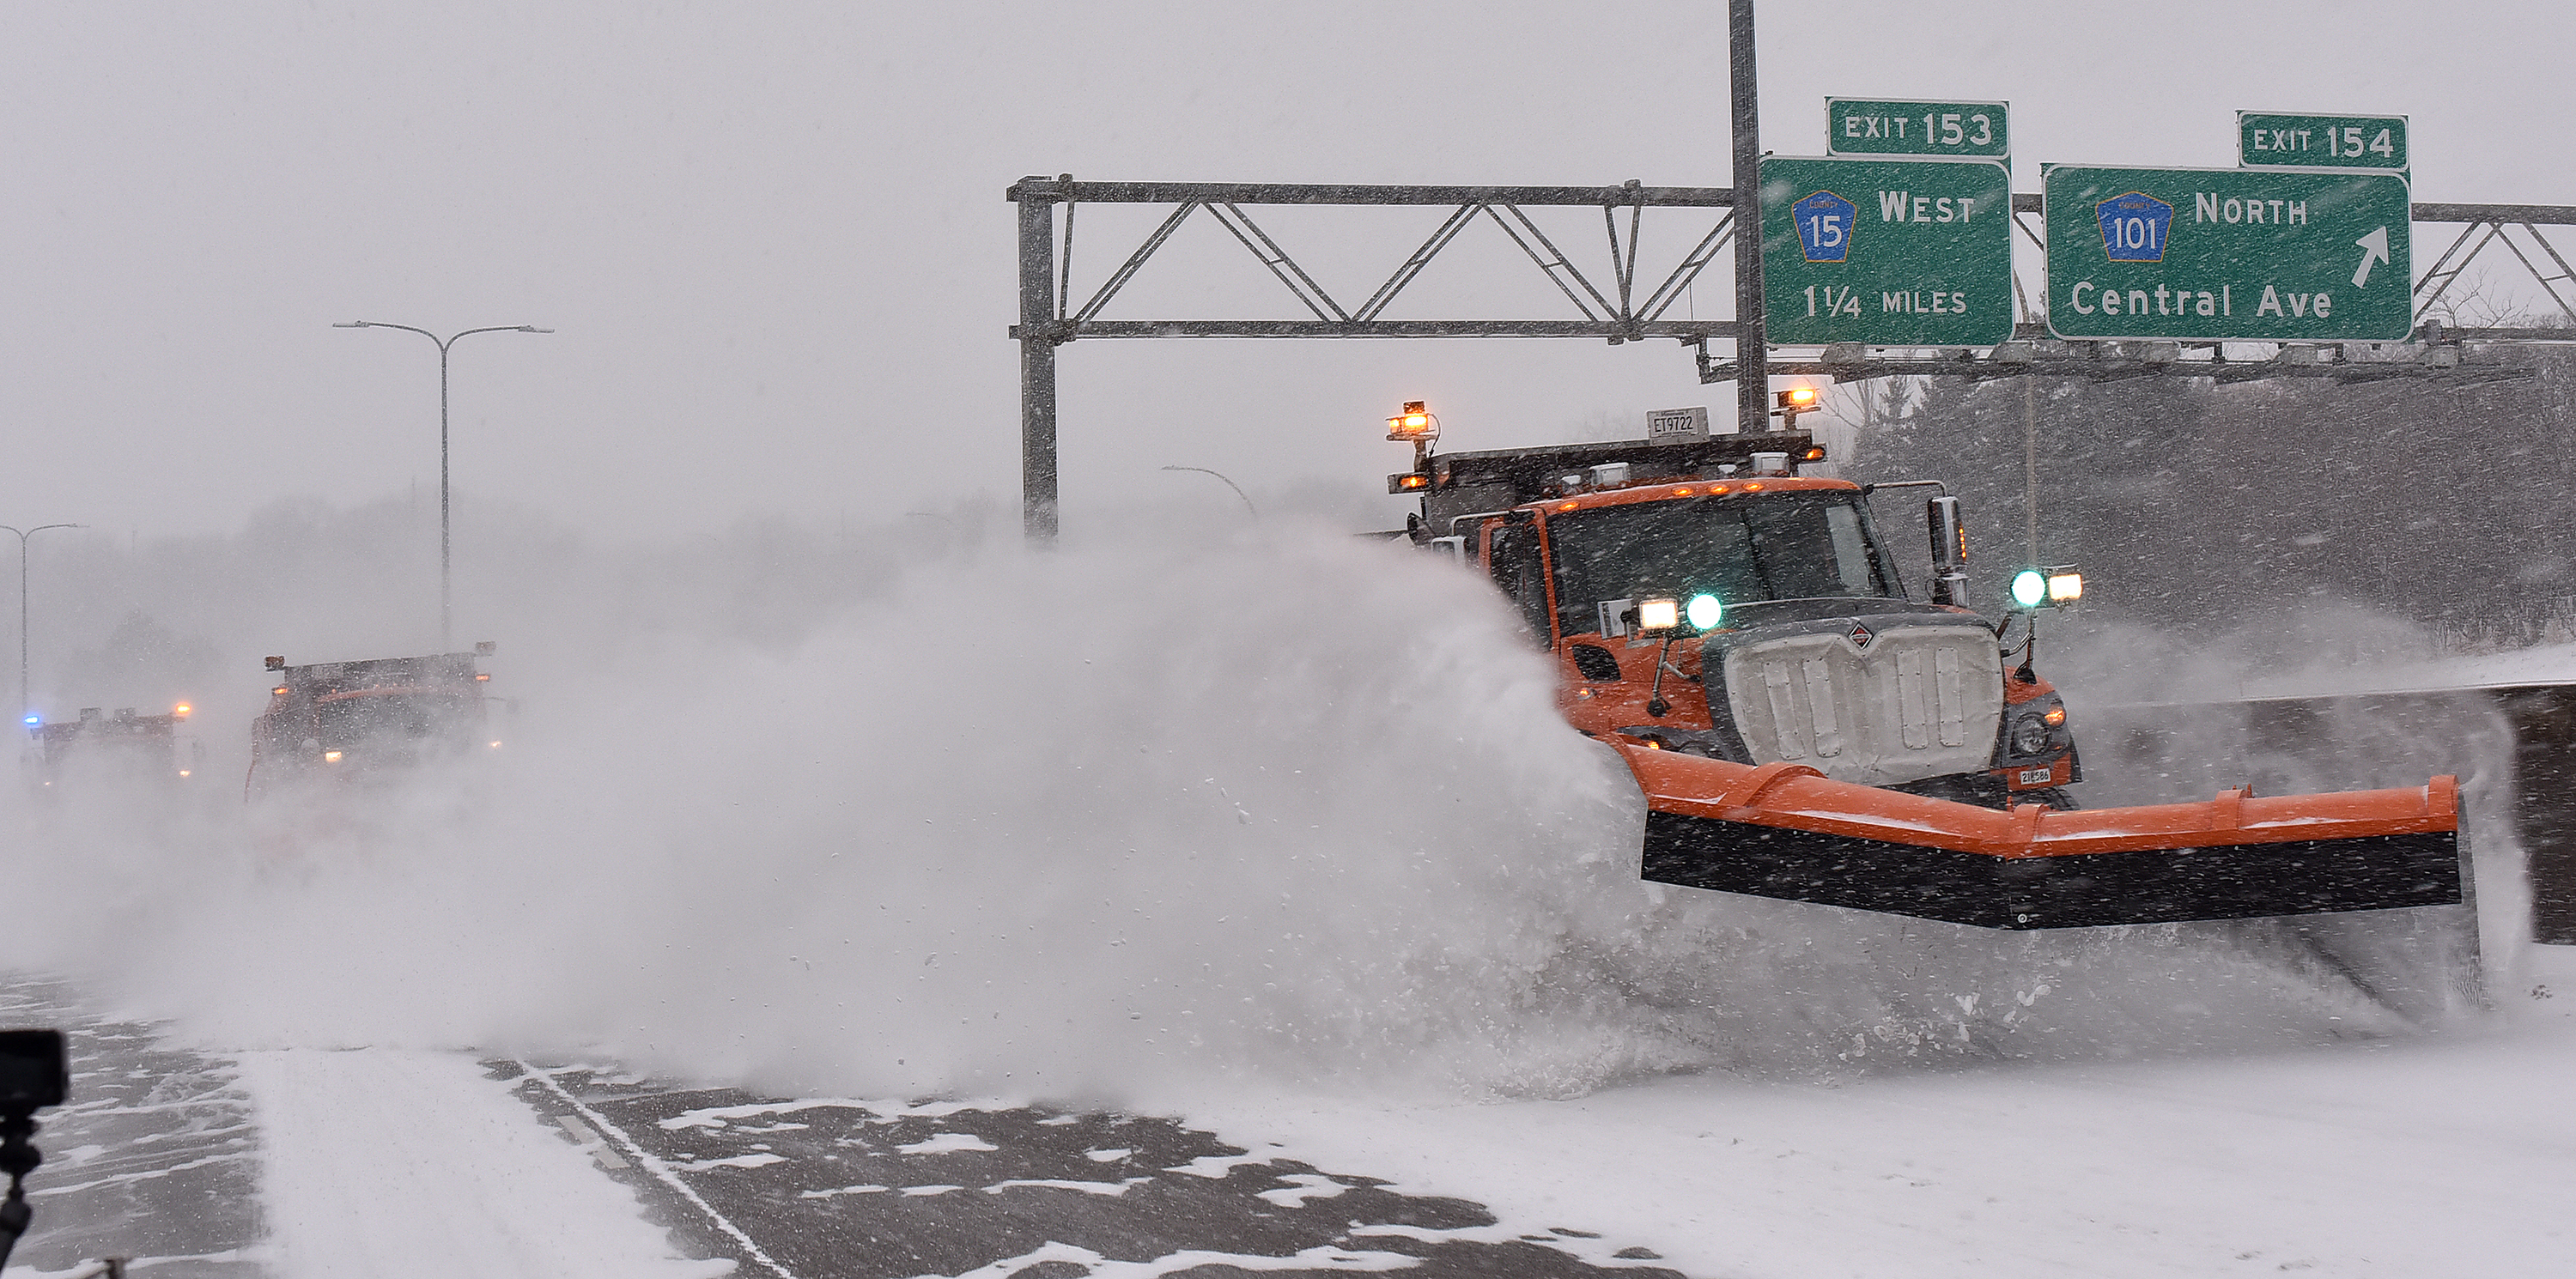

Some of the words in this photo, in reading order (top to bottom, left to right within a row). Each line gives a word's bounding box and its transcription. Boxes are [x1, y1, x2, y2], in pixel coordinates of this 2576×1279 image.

[1845, 117, 1908, 137] EXIT
[1923, 113, 1991, 145] 153
[2254, 130, 2311, 151] EXIT
[2328, 127, 2394, 158] 154
[1879, 191, 1974, 222] WEST
[2196, 193, 2306, 225] NORTH
[1811, 215, 1842, 247] 15
[2114, 218, 2156, 249] 101
[1882, 292, 1966, 313] MILES
[2072, 282, 2231, 316] Central
[2257, 286, 2331, 318] Ave
[1654, 416, 1693, 432] ET9722
